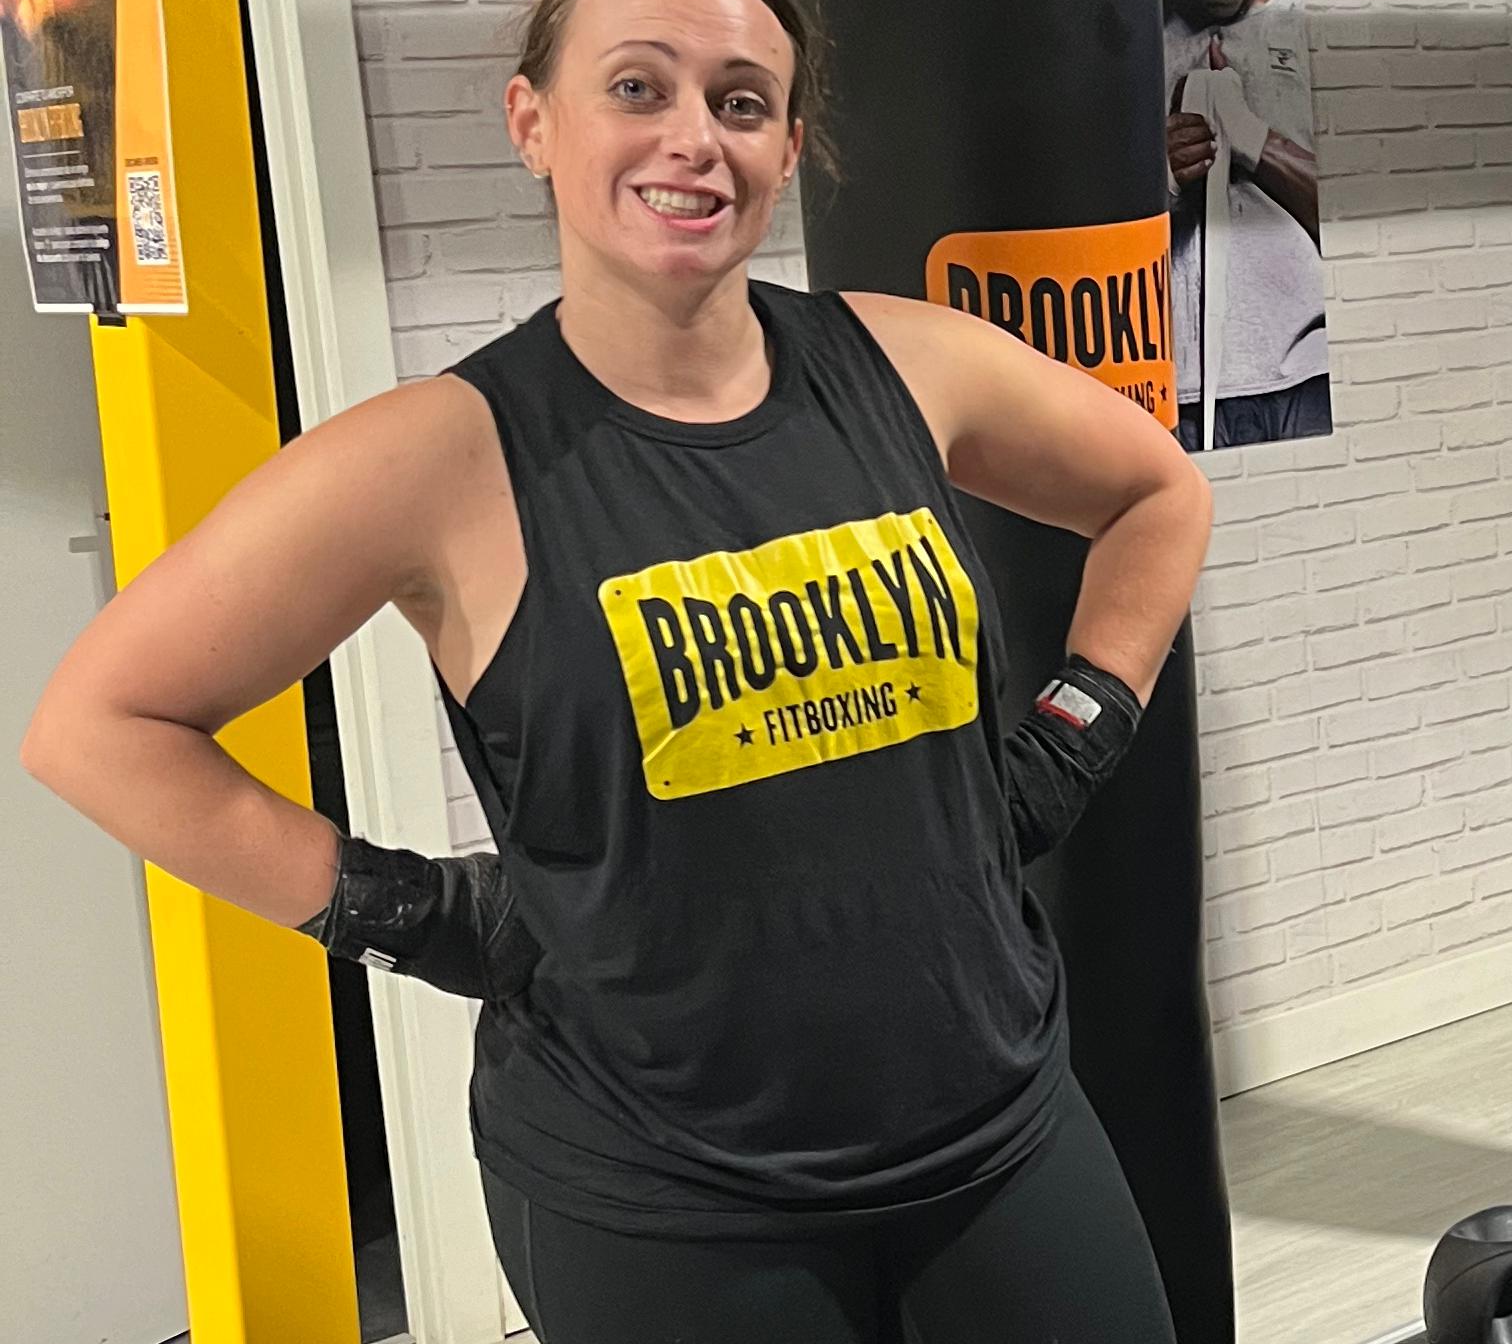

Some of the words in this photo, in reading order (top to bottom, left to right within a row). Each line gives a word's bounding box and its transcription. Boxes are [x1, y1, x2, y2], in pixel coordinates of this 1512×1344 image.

[946, 247, 1174, 369] ROOKLY
[637, 535, 971, 730] BROOKLYN
[762, 681, 898, 747] FITBOXING
